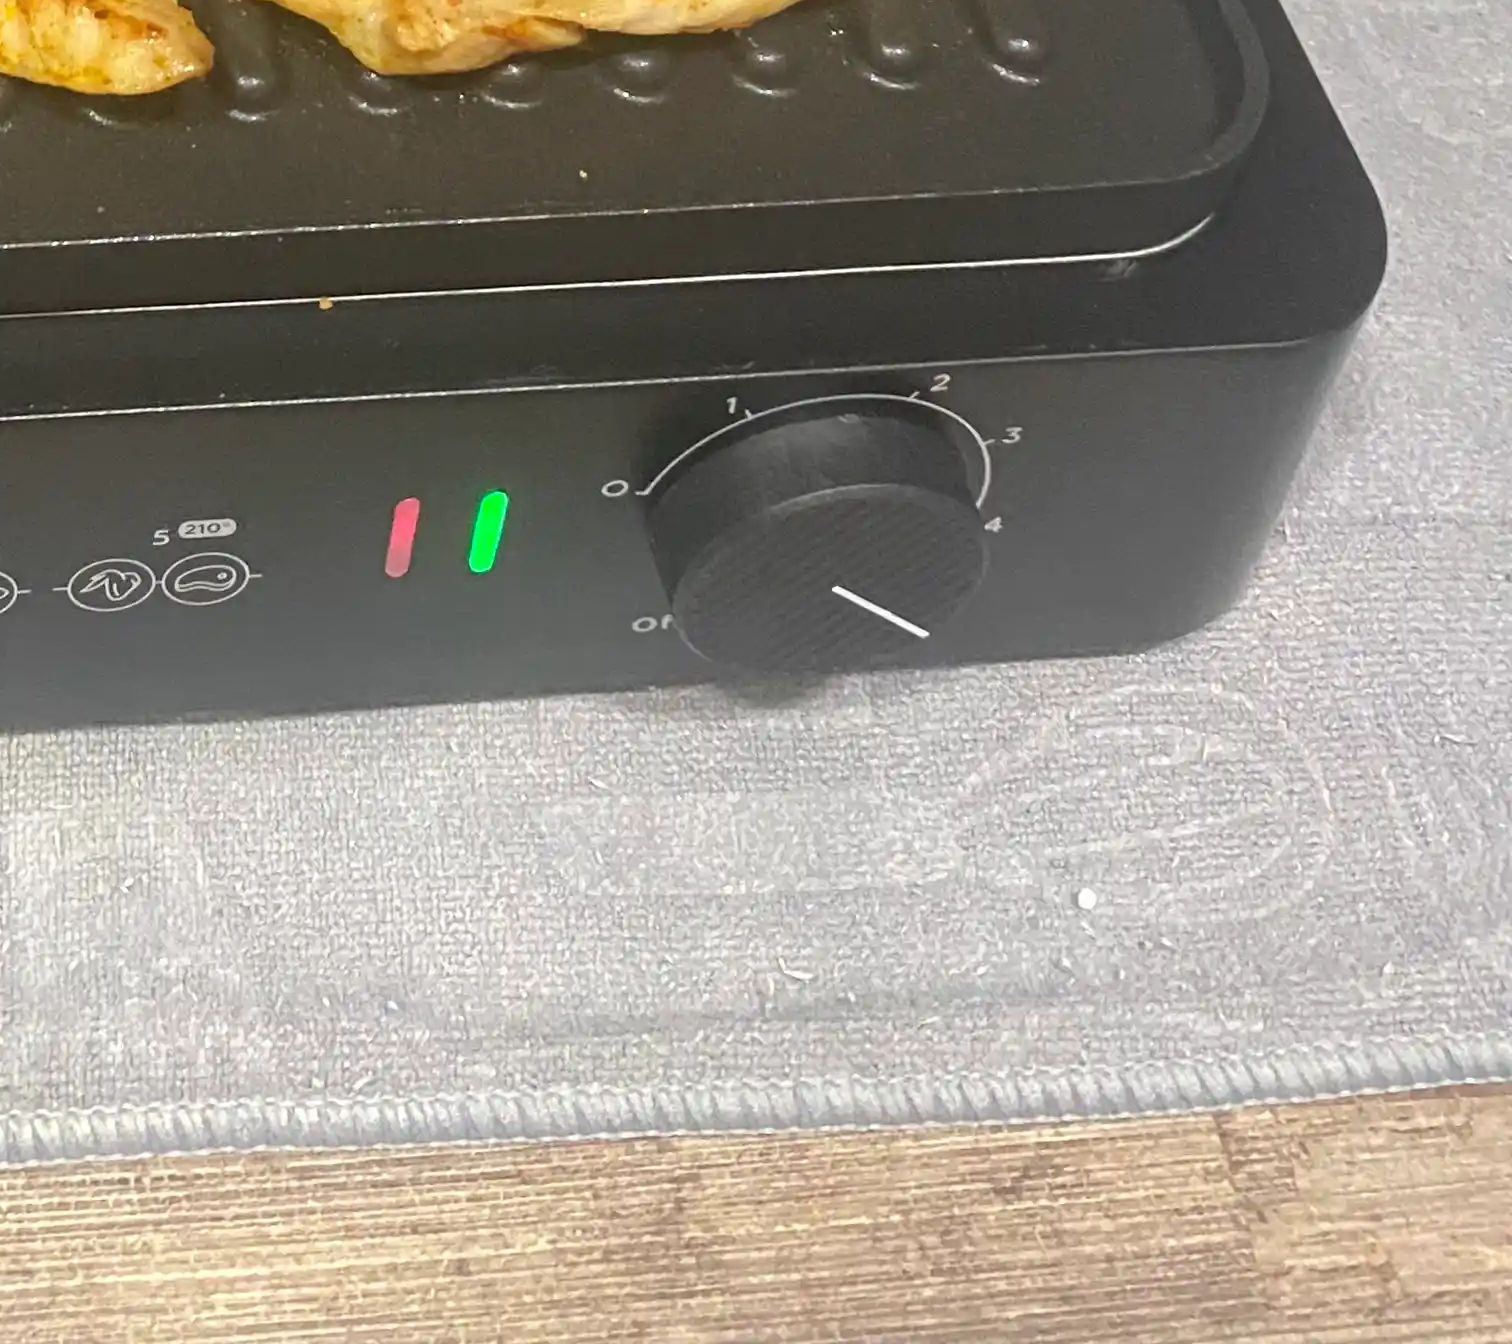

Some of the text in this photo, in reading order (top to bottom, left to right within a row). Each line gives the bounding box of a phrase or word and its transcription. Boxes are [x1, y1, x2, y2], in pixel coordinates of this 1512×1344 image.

[930, 373, 951, 392] 2
[726, 396, 737, 414] 1
[1001, 426, 1023, 444] 3
[984, 516, 1003, 533] 4
[152, 529, 170, 546] 5
